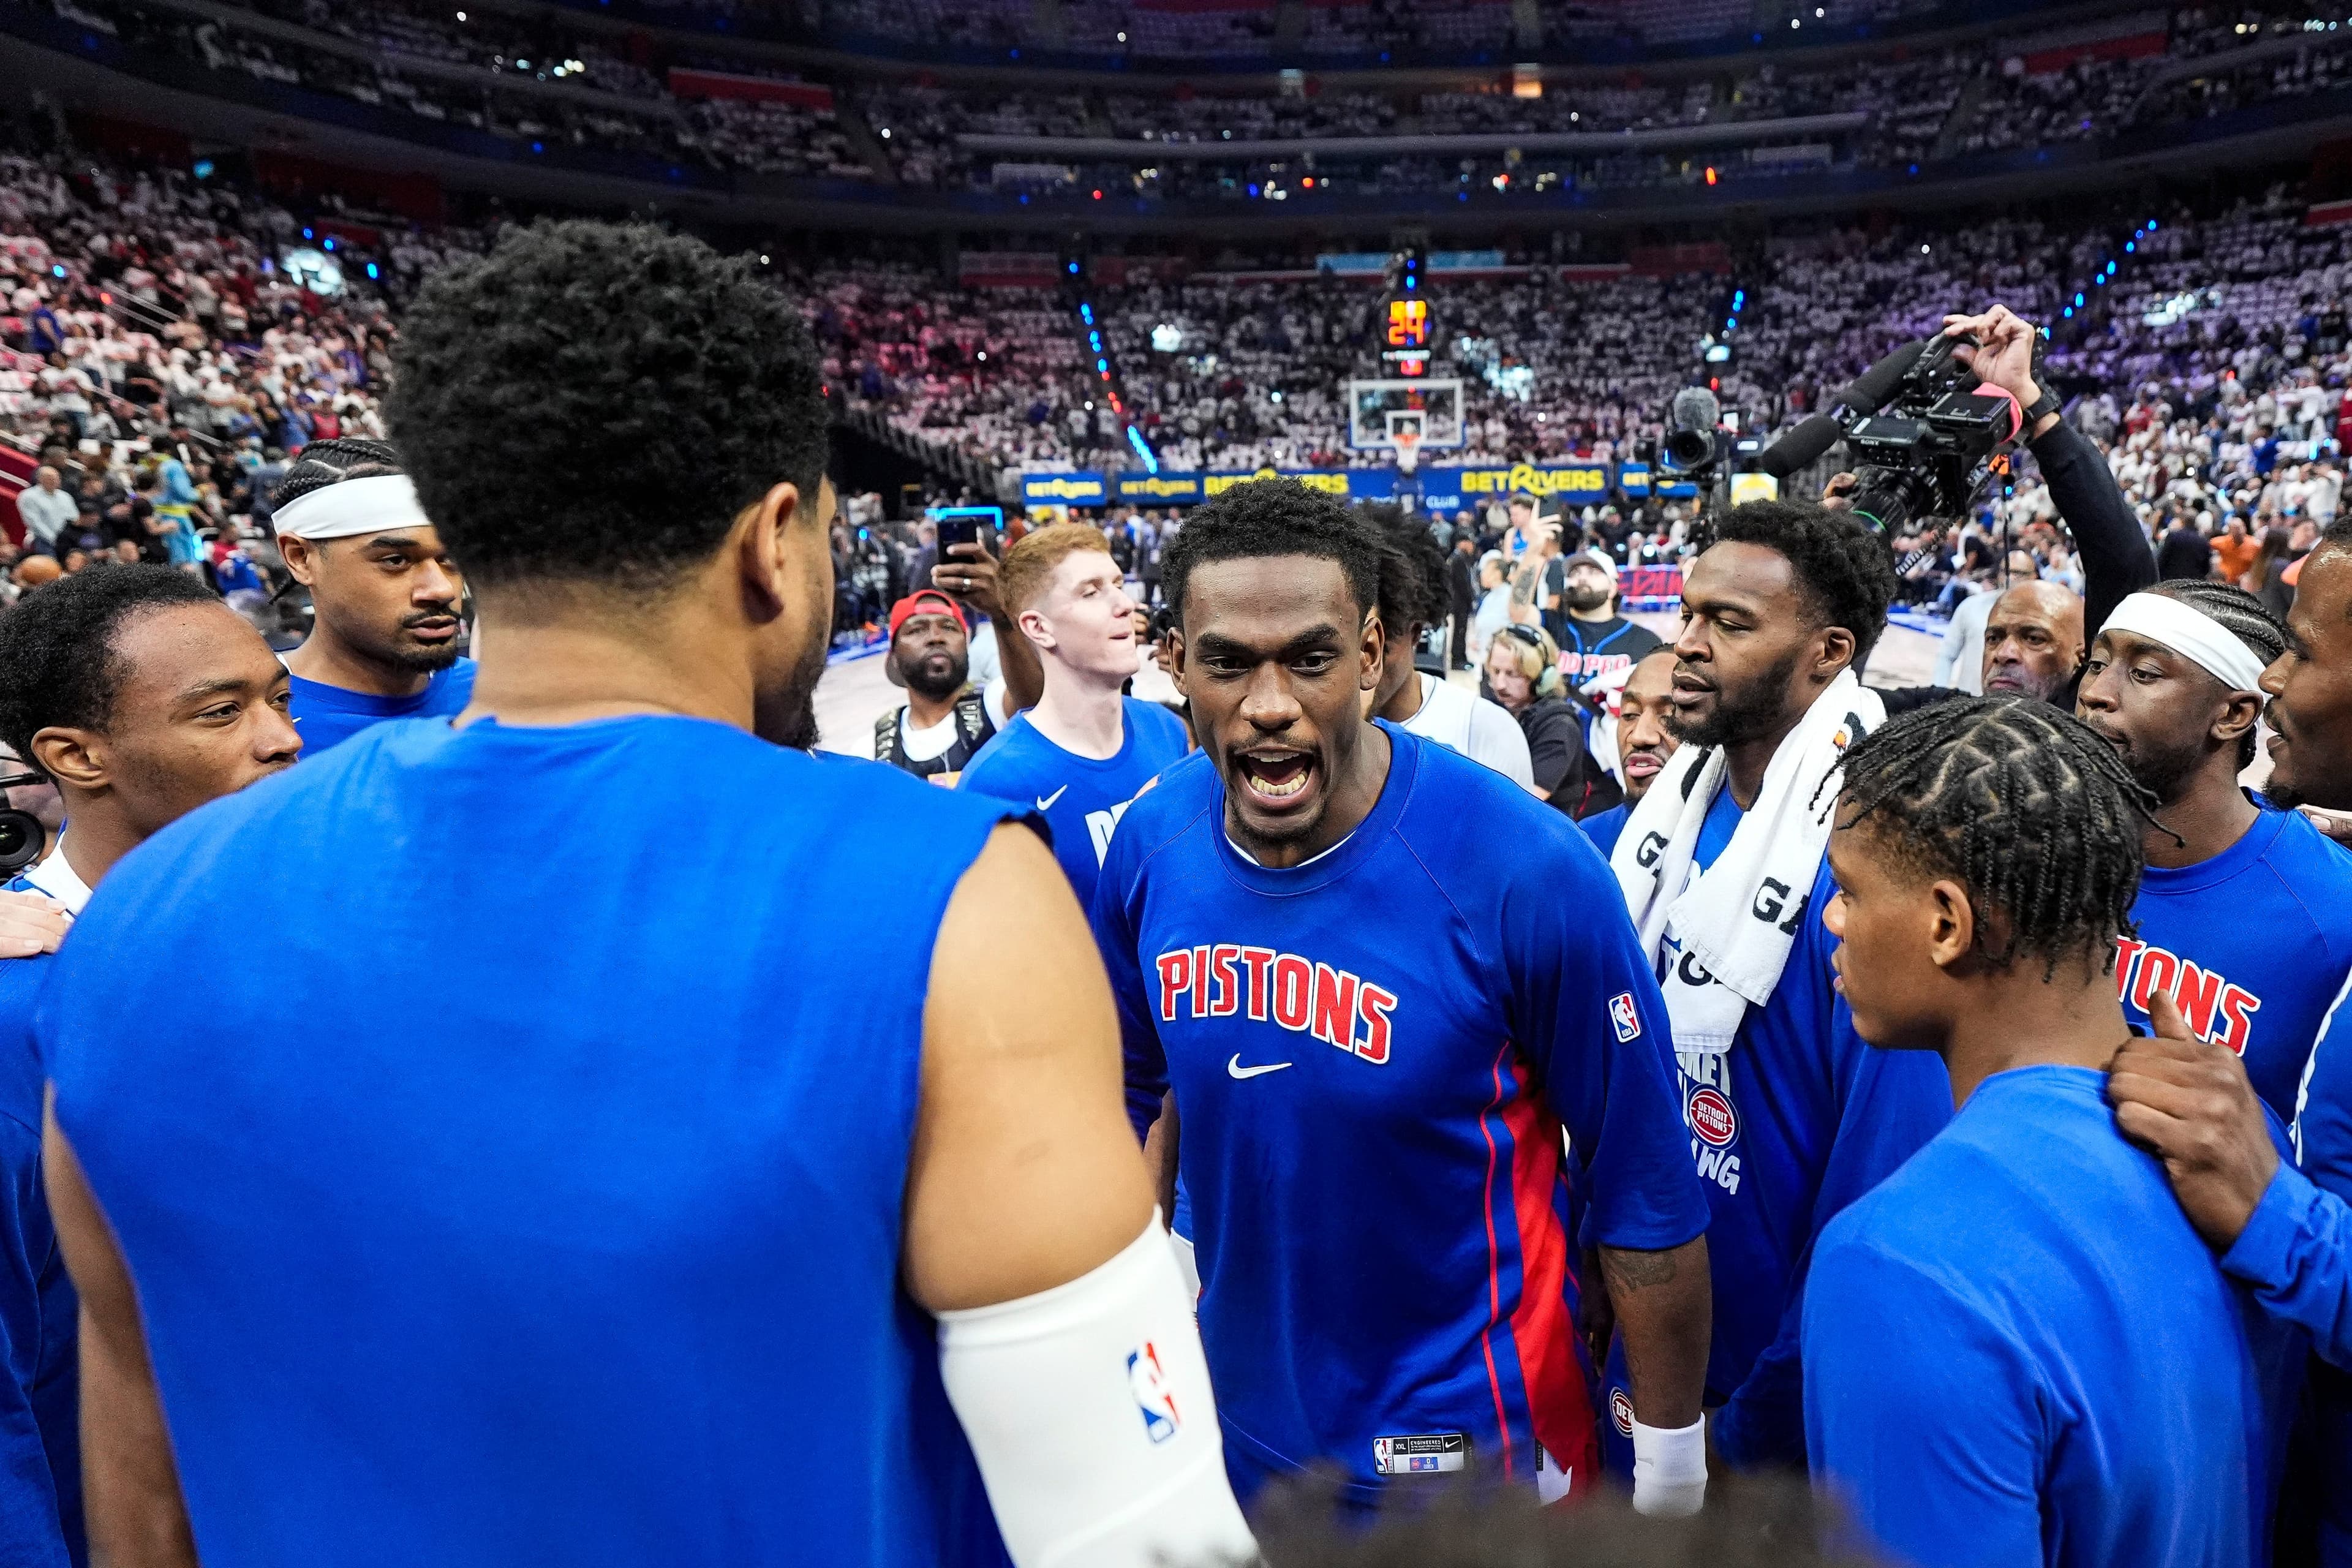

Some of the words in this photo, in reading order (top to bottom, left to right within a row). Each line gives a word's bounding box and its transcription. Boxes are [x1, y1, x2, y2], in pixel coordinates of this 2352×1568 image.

[1388, 313, 1425, 345] 24
[1460, 464, 1605, 496] BETRIVERS
[1156, 943, 1398, 1065] PISTONS
[1621, 1027, 1633, 1038] NBA
[1697, 1101, 1728, 1123] DETROIT
[1697, 1110, 1728, 1133] PISTONS
